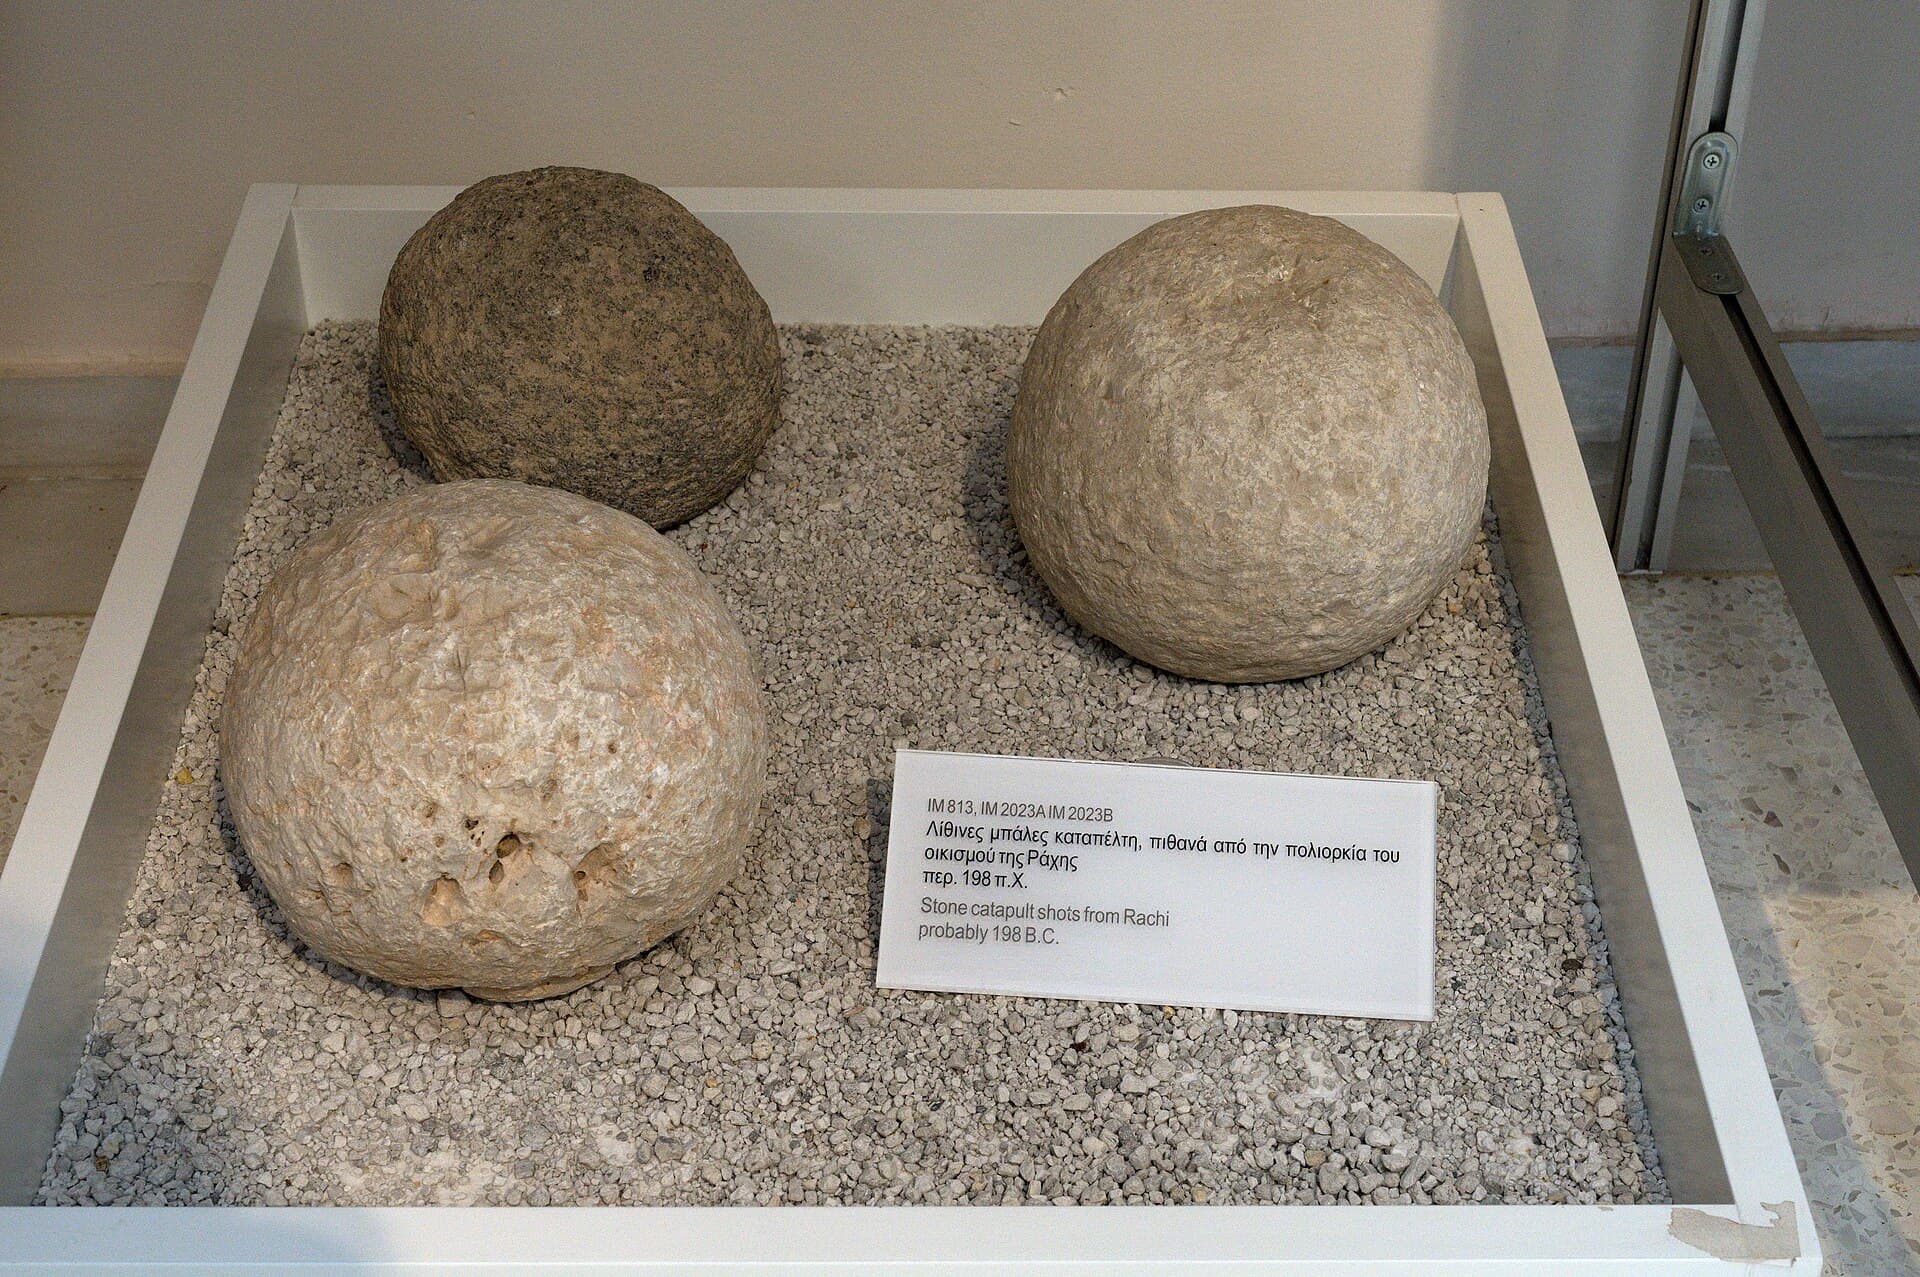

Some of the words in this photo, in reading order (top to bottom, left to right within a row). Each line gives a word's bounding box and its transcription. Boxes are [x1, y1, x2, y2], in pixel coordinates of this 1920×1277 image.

[926, 821, 984, 843] Λίθινες
[990, 825, 1048, 846] μπάλες
[1055, 831, 1142, 851] καταπέλτη,
[1150, 834, 1207, 851] πιθανά
[1214, 838, 1247, 854] από
[1253, 842, 1279, 859] την
[1286, 842, 1367, 863] πολιορκία
[1373, 849, 1400, 863] του
[925, 847, 995, 865] οικισμού
[999, 852, 1024, 868] της
[1027, 850, 1079, 871] Ράχης
[923, 870, 957, 888] περ.
[963, 870, 991, 886] 198
[921, 897, 967, 915] Stone
[971, 901, 1034, 921] catapult
[1037, 904, 1080, 921] shots
[1083, 906, 1119, 924] from
[1124, 908, 1169, 927] Rachi
[919, 923, 988, 944] probably
[993, 925, 1021, 942] 198
[1025, 927, 1059, 945] B.C.
